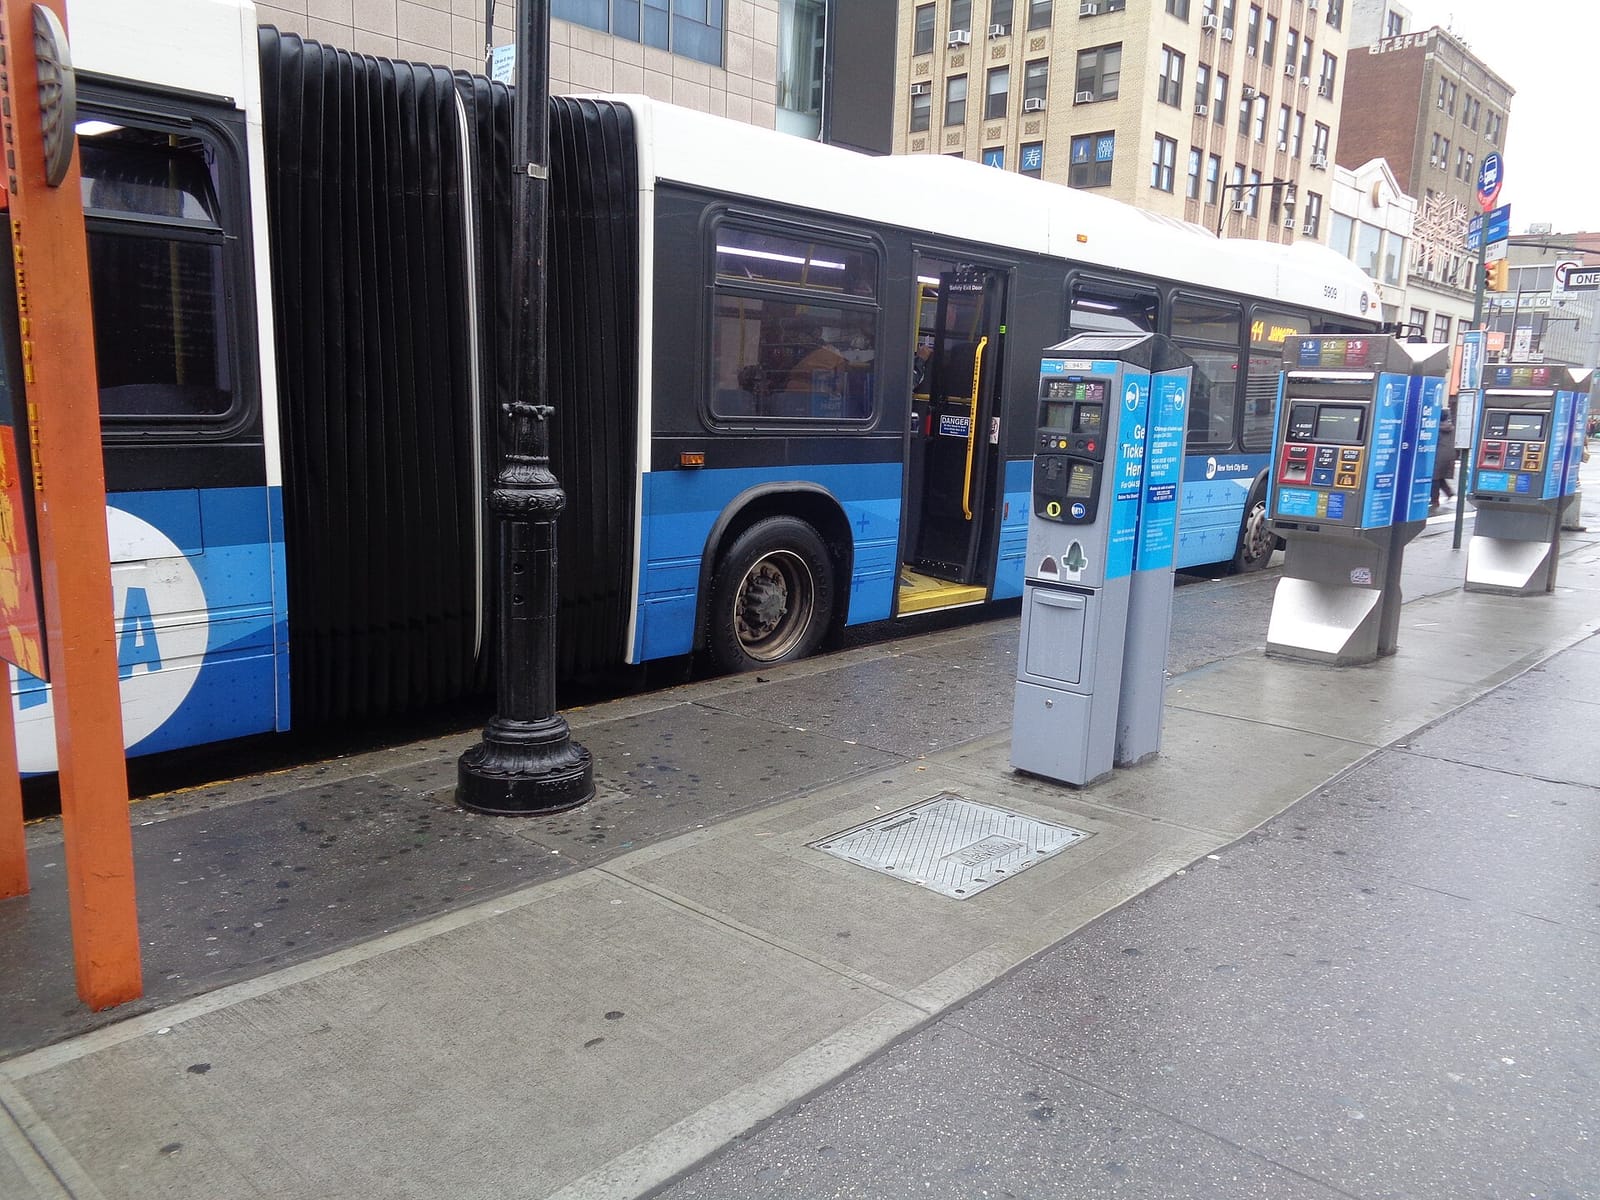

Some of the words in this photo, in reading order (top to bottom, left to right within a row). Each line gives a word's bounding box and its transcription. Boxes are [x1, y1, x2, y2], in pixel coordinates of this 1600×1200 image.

[1575, 273, 1600, 284] ONE
[1323, 284, 1338, 299] 5909
[941, 417, 969, 426] DANGER
[1134, 424, 1146, 440] Ge
[1122, 443, 1144, 459] Ticke
